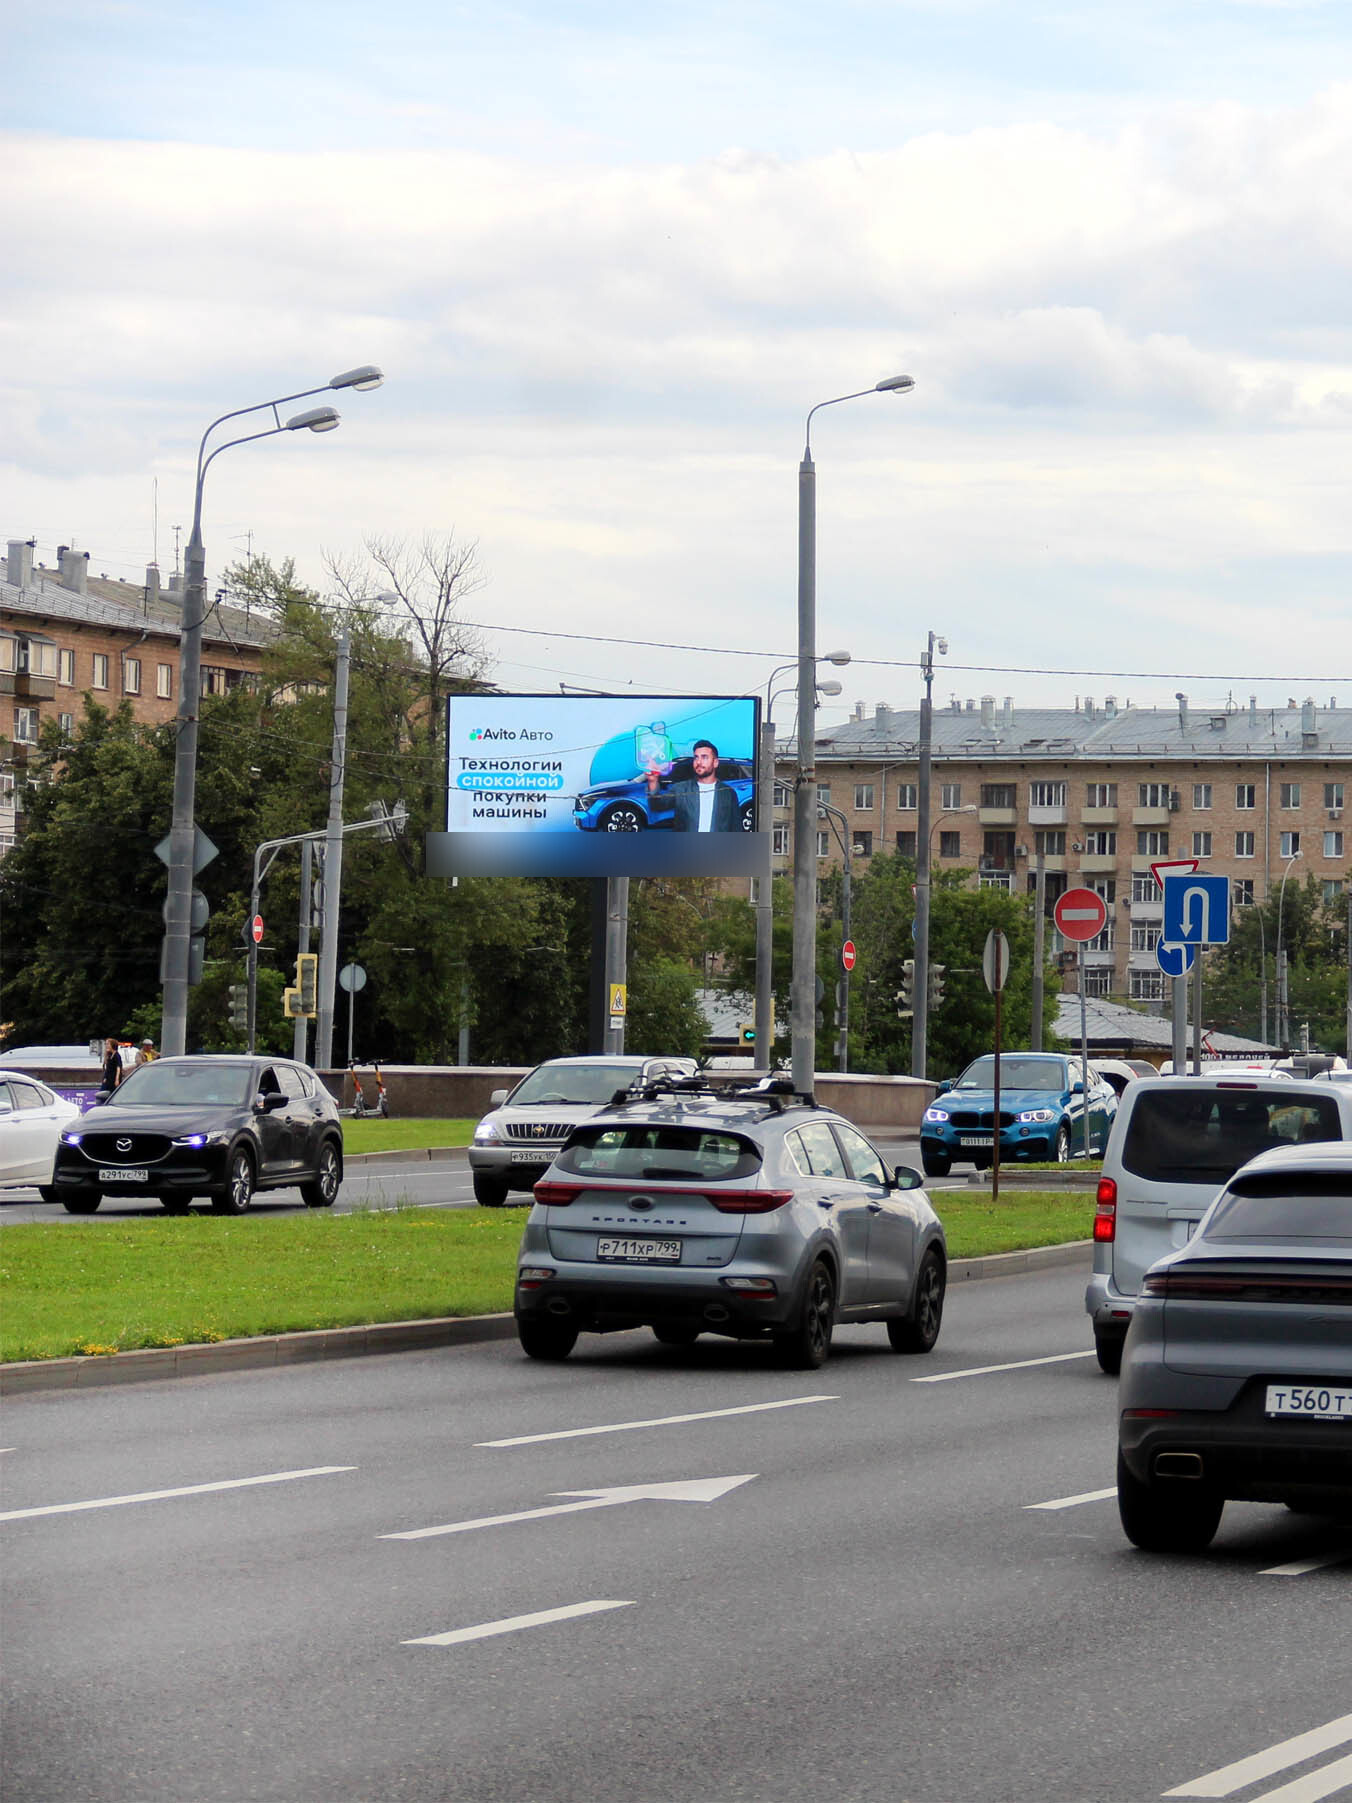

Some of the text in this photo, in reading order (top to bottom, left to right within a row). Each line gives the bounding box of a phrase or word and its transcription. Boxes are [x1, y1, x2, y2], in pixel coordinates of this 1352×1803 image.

[483, 728, 553, 741] Avito Авто
[458, 758, 562, 771] Технологии
[461, 772, 559, 787] спокойной
[472, 791, 547, 806] покупки
[472, 808, 547, 819] машины
